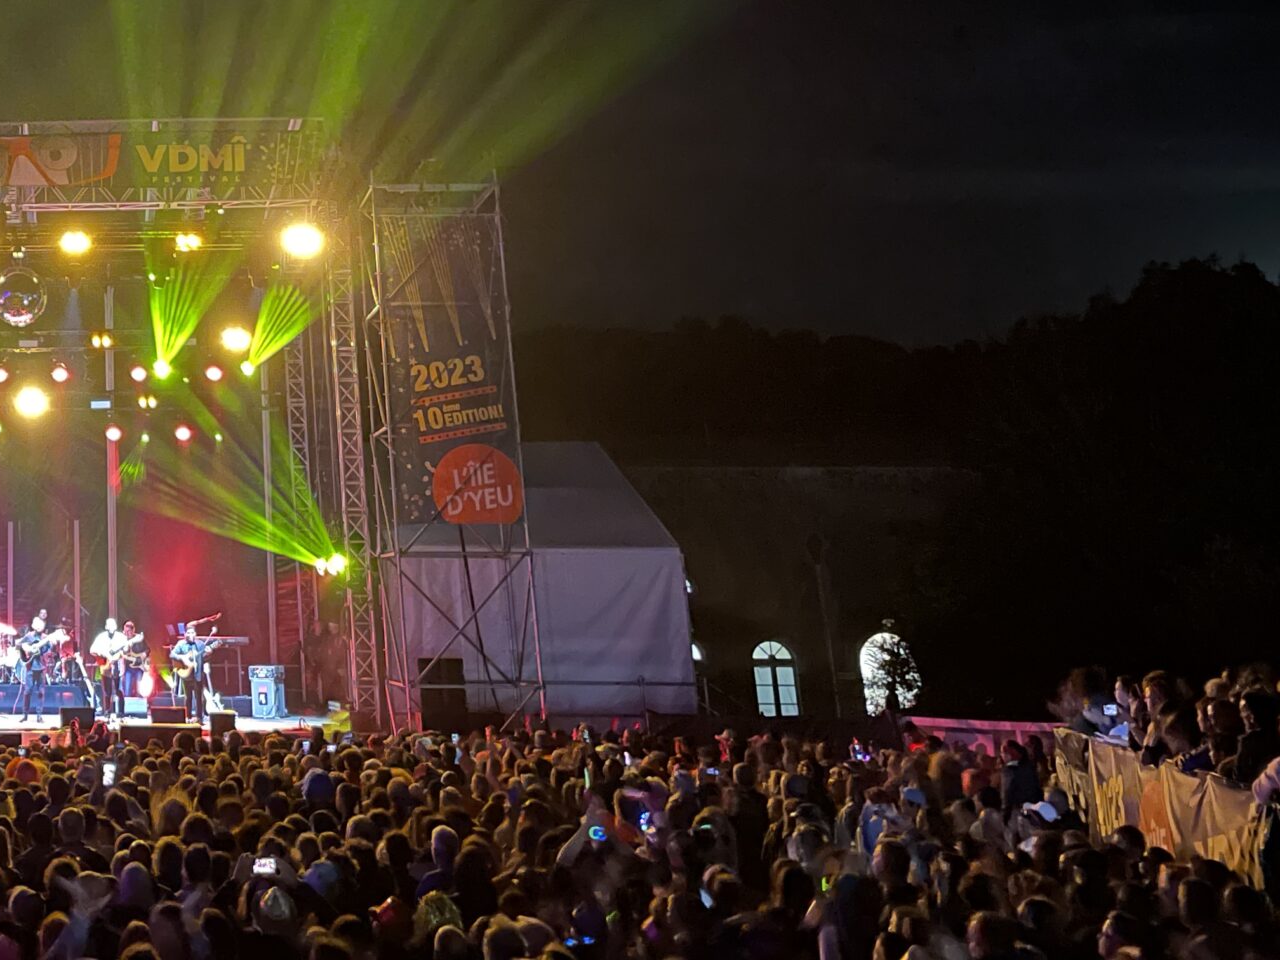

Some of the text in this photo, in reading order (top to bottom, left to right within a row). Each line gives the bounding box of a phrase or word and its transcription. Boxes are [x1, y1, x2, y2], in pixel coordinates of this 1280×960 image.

[411, 355, 485, 392] 2023
[444, 404, 504, 427] EDITION!
[447, 484, 513, 516] D'YEU
